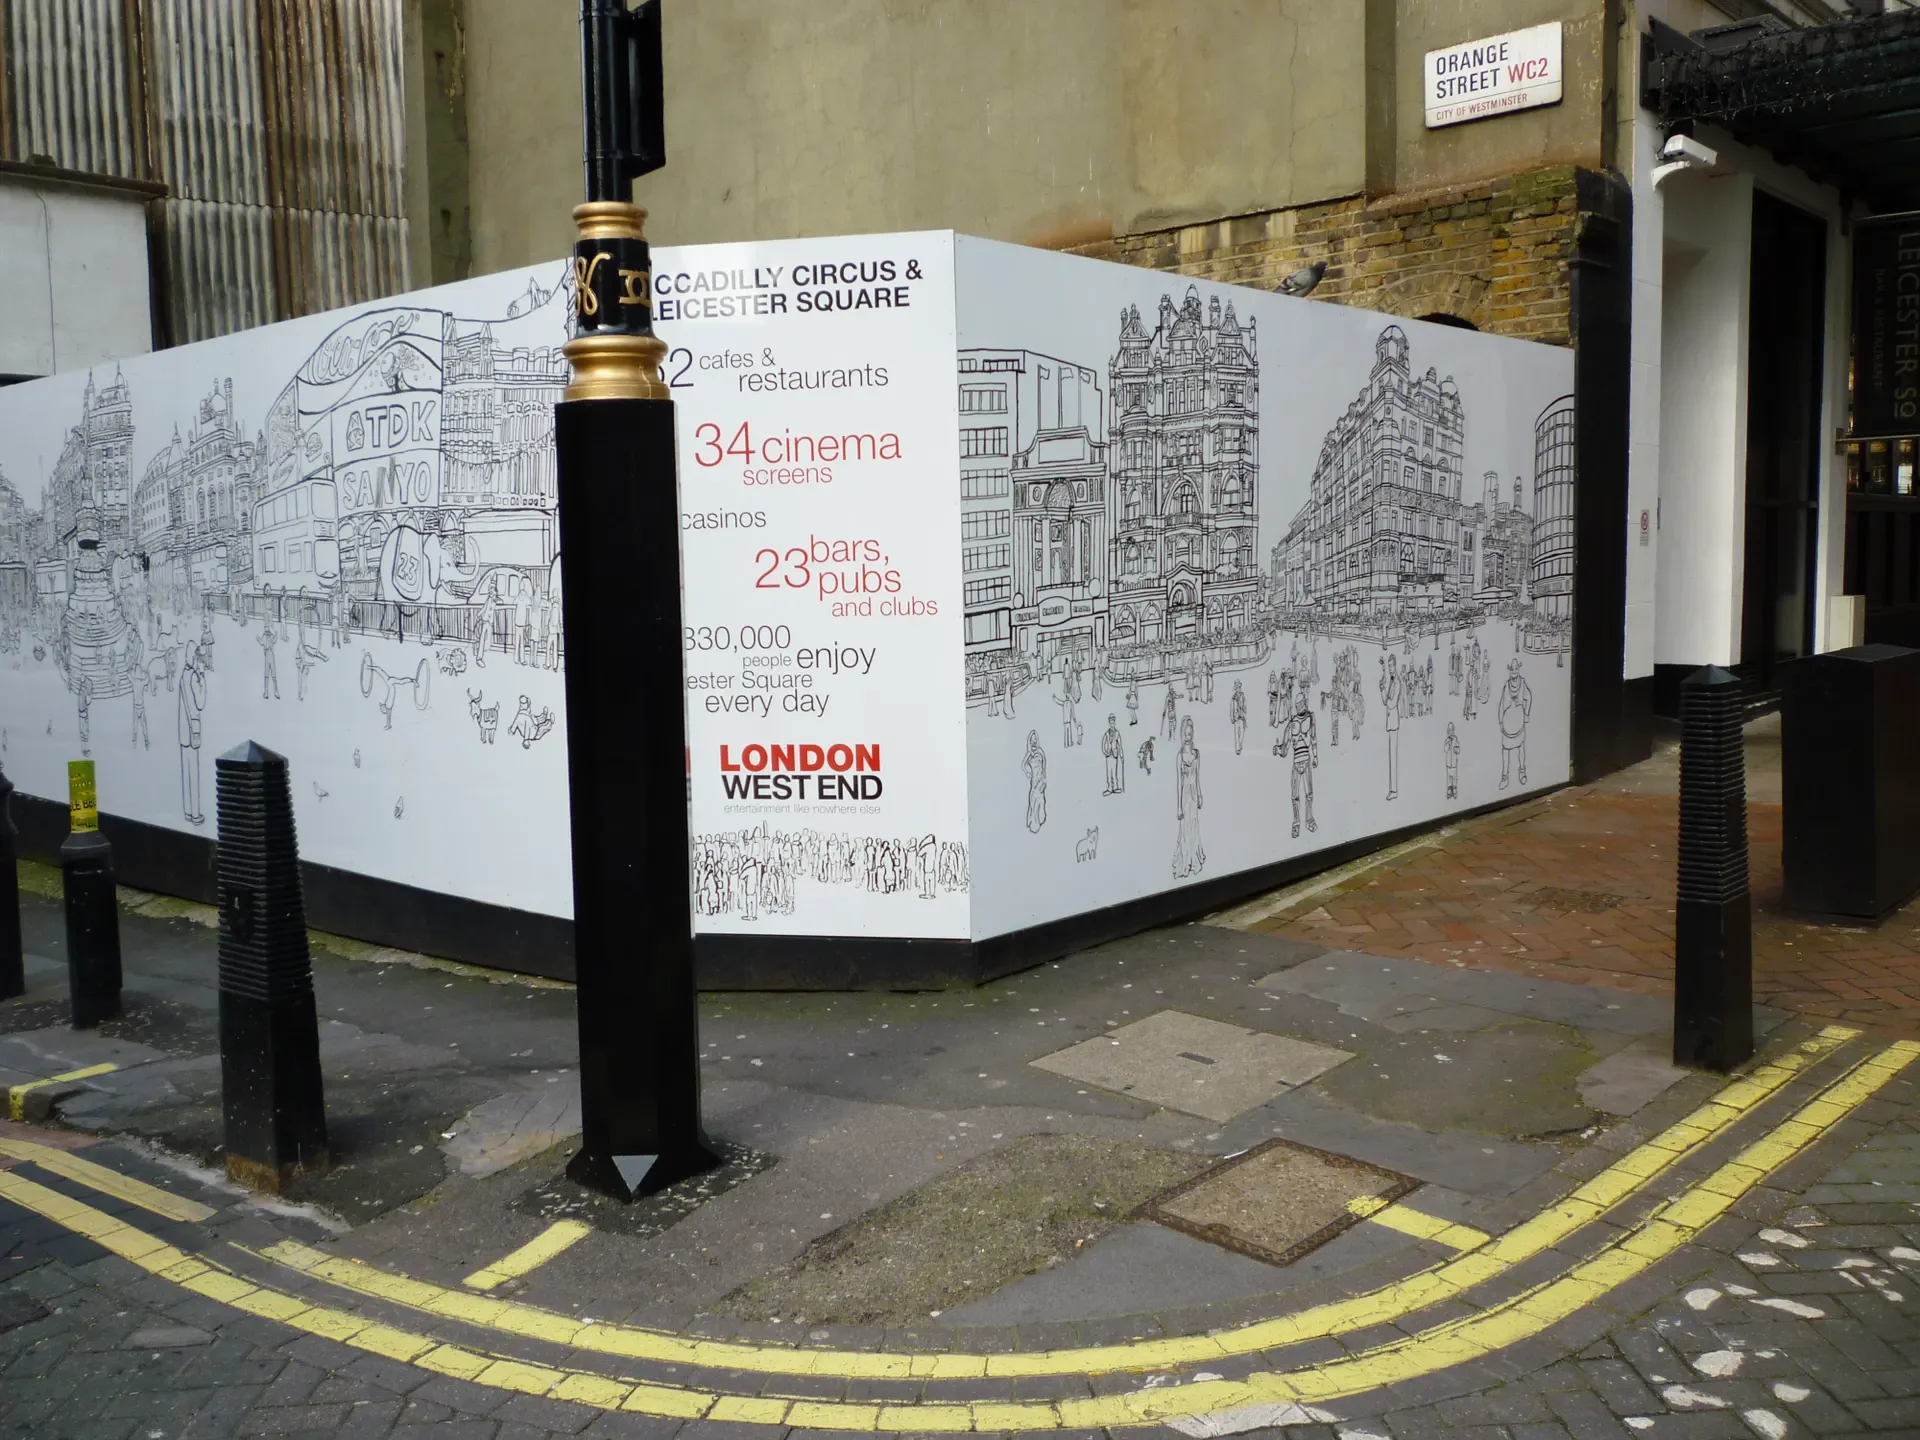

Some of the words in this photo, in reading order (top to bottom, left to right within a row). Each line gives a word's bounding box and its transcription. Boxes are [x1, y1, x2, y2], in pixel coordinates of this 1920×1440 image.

[1436, 41, 1509, 76] ORANGE
[1436, 68, 1500, 99] STREET
[1507, 57, 1548, 84] WC2
[1436, 108, 1453, 121] CITY
[1456, 107, 1467, 117] OF
[1468, 93, 1528, 114] WESTMINSTER
[655, 266, 784, 295] CCADILLY
[792, 260, 897, 287] CIRCUS
[905, 259, 923, 280] &
[653, 293, 787, 321] EICESTER
[796, 286, 910, 312] SQUARE
[1895, 231, 1920, 377] LEICESTER
[700, 350, 754, 370] cafes
[761, 347, 776, 367] &
[739, 363, 889, 392] restaurants
[366, 400, 437, 448] TDK
[695, 421, 756, 467] 34
[762, 428, 902, 464] cinema
[343, 457, 432, 510] SANYO
[743, 466, 832, 486] screens
[755, 548, 810, 588] 23
[810, 534, 890, 566] bars,
[818, 564, 902, 602] pubs
[831, 597, 872, 618] and
[879, 596, 939, 617] clubs
[742, 653, 792, 669] people
[796, 641, 877, 675] enjoy
[687, 672, 735, 690] ester
[741, 670, 813, 692] Square
[705, 694, 773, 718] every
[782, 688, 830, 718] day
[720, 743, 881, 772] LONDON
[721, 774, 811, 800] WEST
[817, 774, 883, 800] END
[723, 804, 791, 814] entertainment
[793, 803, 810, 814] like
[812, 803, 857, 814] nowhere
[859, 803, 881, 814] else
